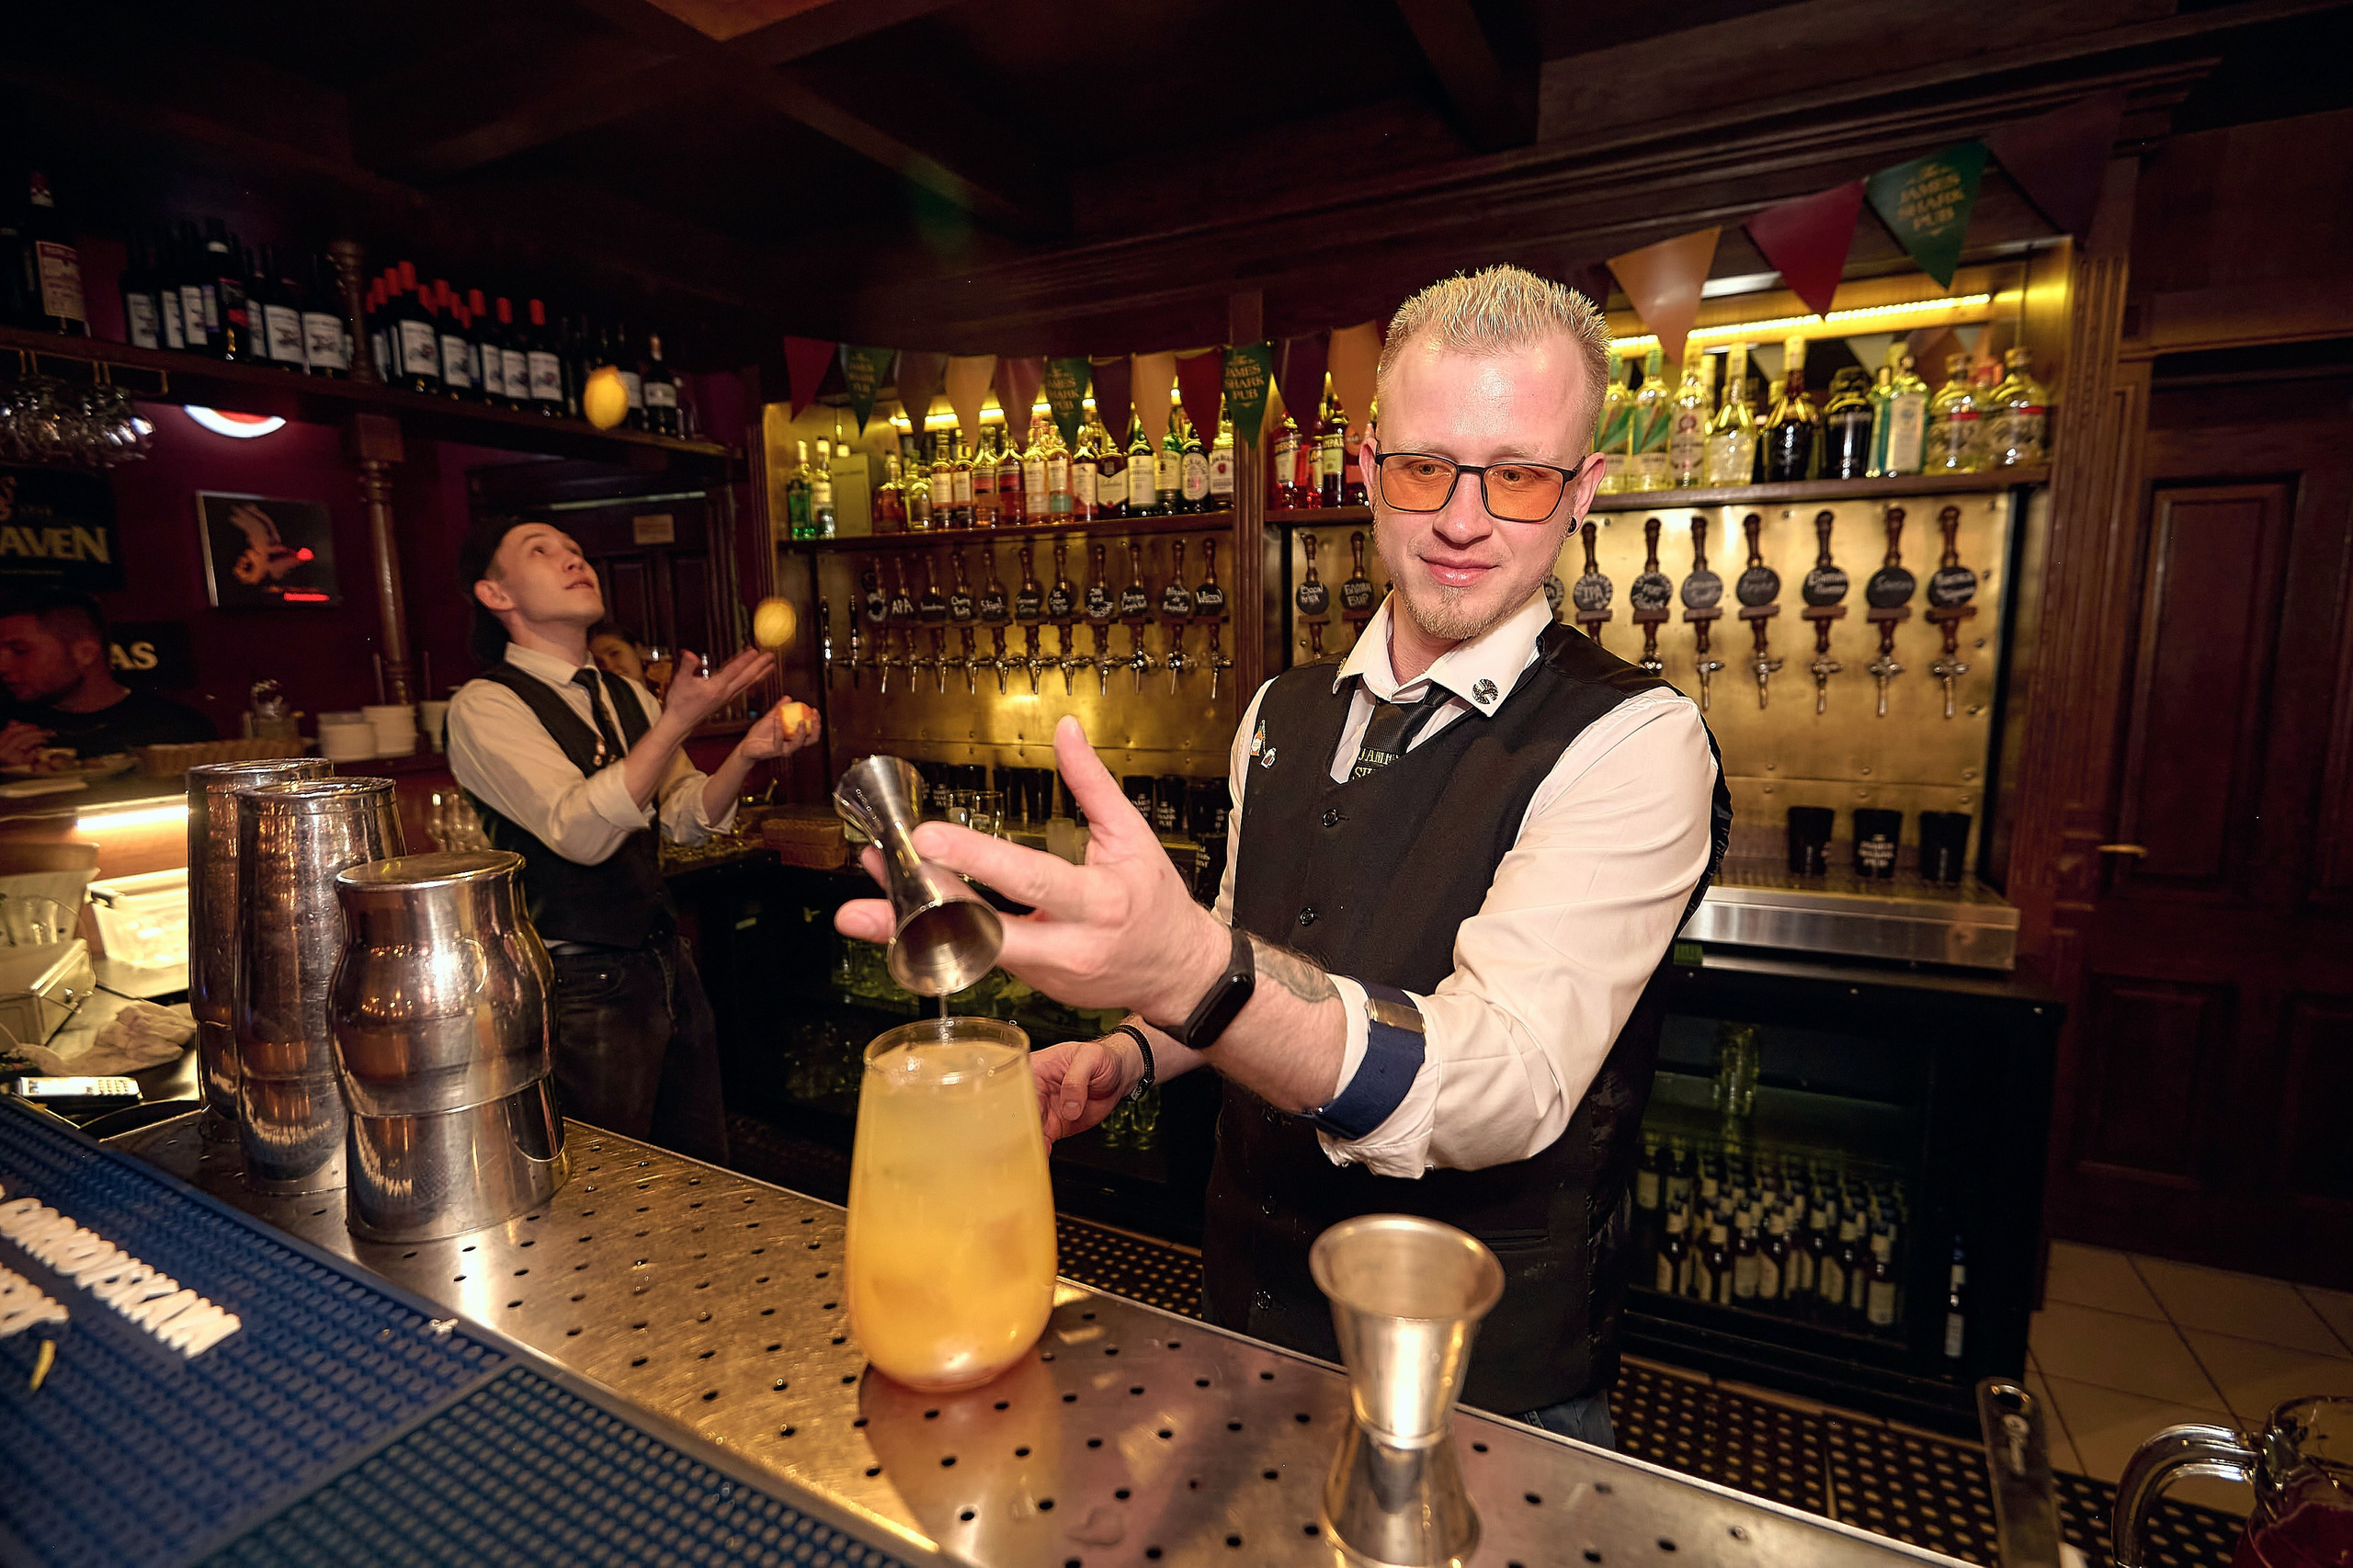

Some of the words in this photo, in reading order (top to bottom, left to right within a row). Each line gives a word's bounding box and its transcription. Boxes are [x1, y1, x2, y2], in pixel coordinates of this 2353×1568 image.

[1225, 364, 1261, 378] JAMES
[1224, 376, 1265, 389] SHARK
[1233, 389, 1258, 401] PUB
[892, 598, 914, 615] APA
[1358, 747, 1399, 766] JAME
